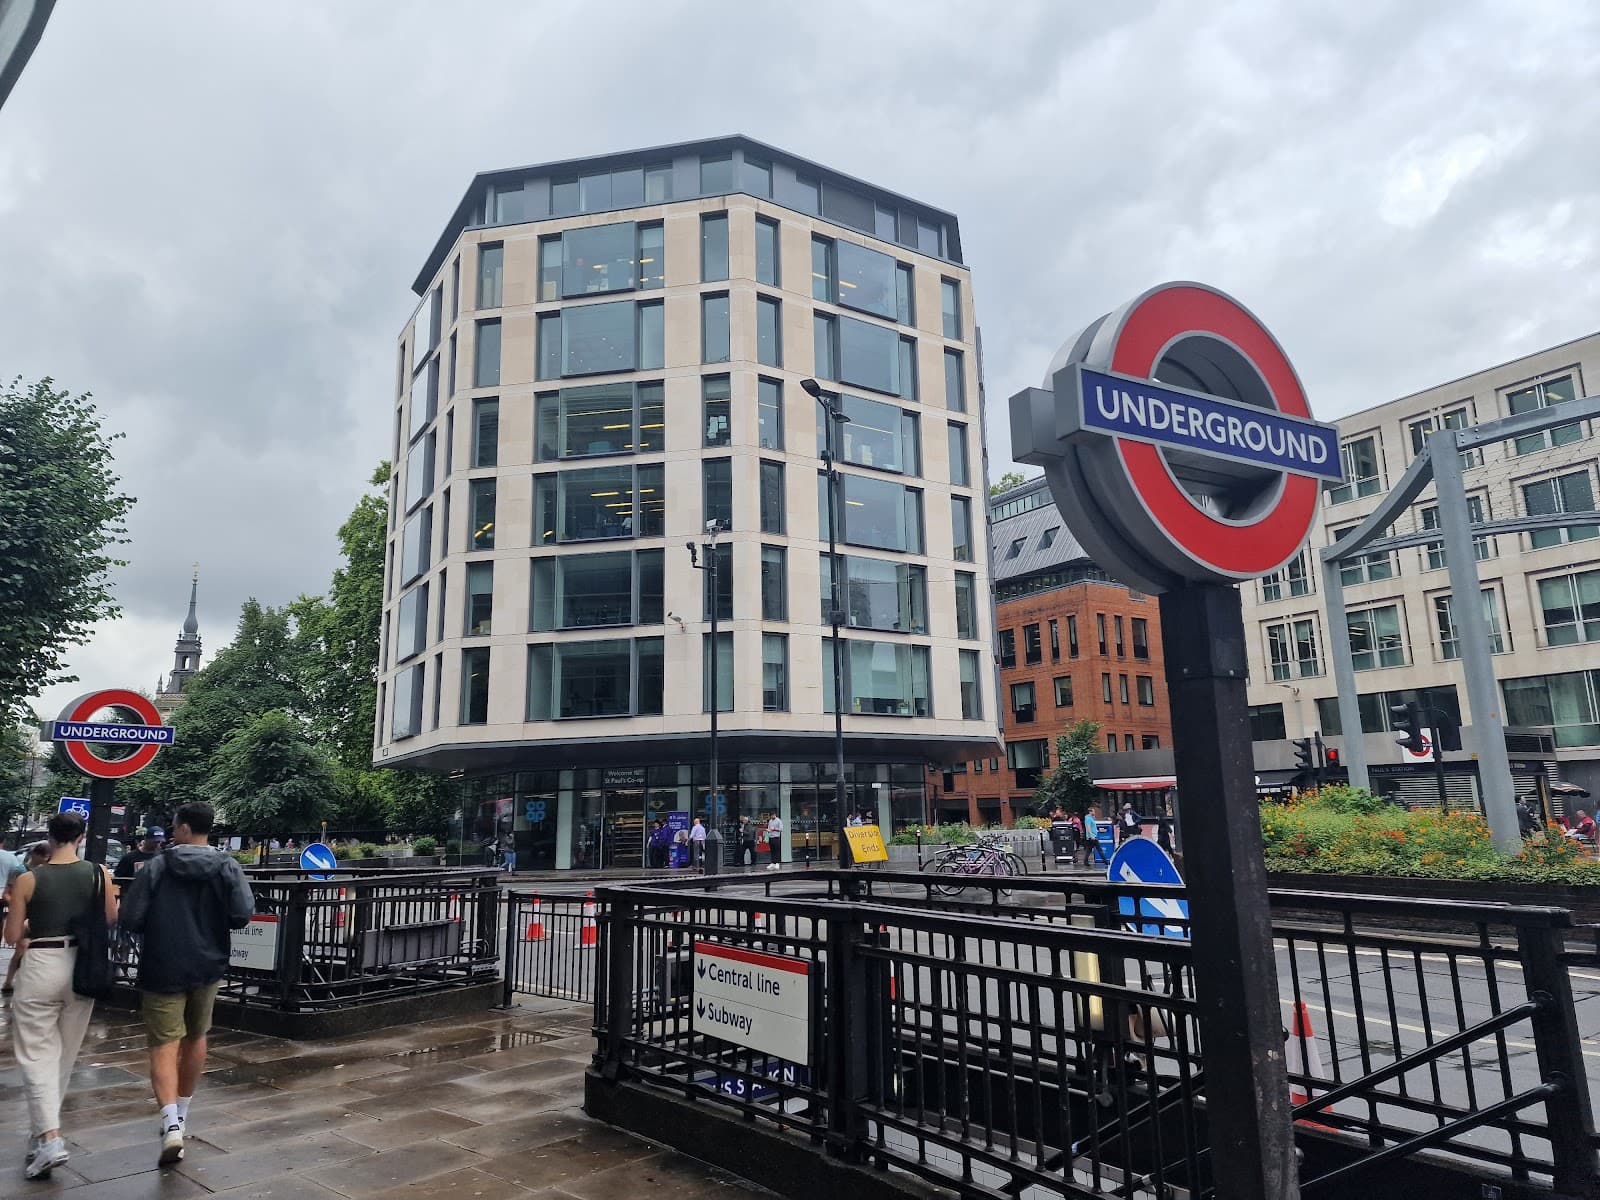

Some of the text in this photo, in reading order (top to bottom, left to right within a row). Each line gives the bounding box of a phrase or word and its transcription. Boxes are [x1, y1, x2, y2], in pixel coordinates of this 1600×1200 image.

[1096, 386, 1328, 464] UNDERGROUND
[60, 725, 168, 740] UNDERGROUND
[627, 777, 645, 785] Co-op
[861, 843, 880, 855] Ends
[251, 926, 264, 937] line
[708, 962, 780, 996] Central line
[708, 1002, 753, 1036] Subway
